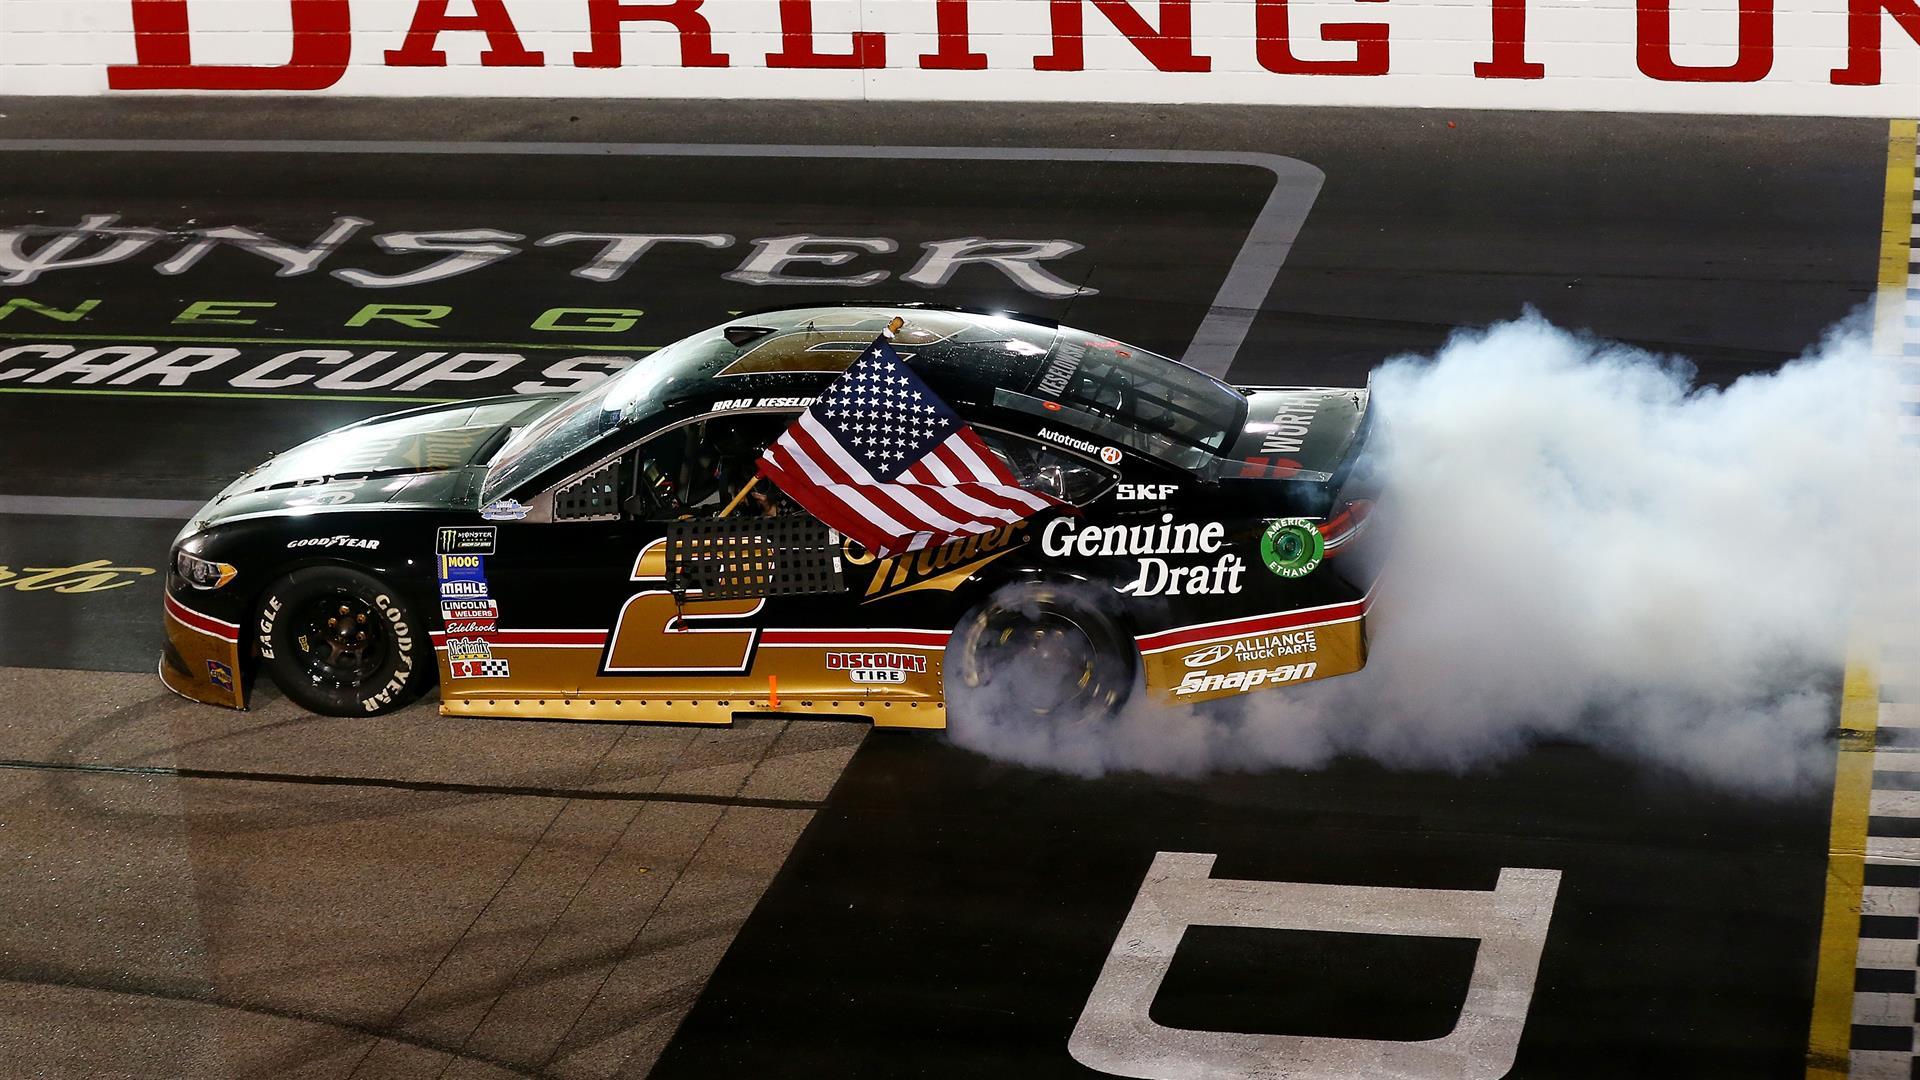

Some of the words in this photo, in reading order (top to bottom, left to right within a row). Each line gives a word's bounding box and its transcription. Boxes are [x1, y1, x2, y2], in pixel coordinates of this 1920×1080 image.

[0, 298, 743, 332] NERG
[228, 349, 526, 391] CUP
[711, 398, 753, 411] BRAD
[1038, 427, 1100, 455] Autotrader
[1116, 484, 1179, 500] SKF
[1042, 513, 1225, 557] Genuine
[1266, 518, 1319, 538] AMERICAN
[286, 535, 380, 550] GOODYEAR
[448, 556, 480, 568] MOOG
[1269, 558, 1320, 577] ETHANOL
[1113, 553, 1246, 597] Draft
[441, 583, 487, 594] MAHLE
[444, 601, 487, 610] LINCOLN
[603, 536, 775, 672] 2
[260, 595, 283, 659] EAGLE
[446, 622, 496, 634] Edelbrock
[447, 637, 490, 655] Mechanix
[1234, 630, 1316, 652] ALLIANCE
[361, 594, 413, 712] GOODYEAR
[1235, 648, 1275, 662] TRUCK
[1278, 642, 1317, 656] PARTS
[826, 652, 927, 673] DISCOUNT
[855, 670, 899, 680] TIRE
[1172, 662, 1317, 695] Snap-on
